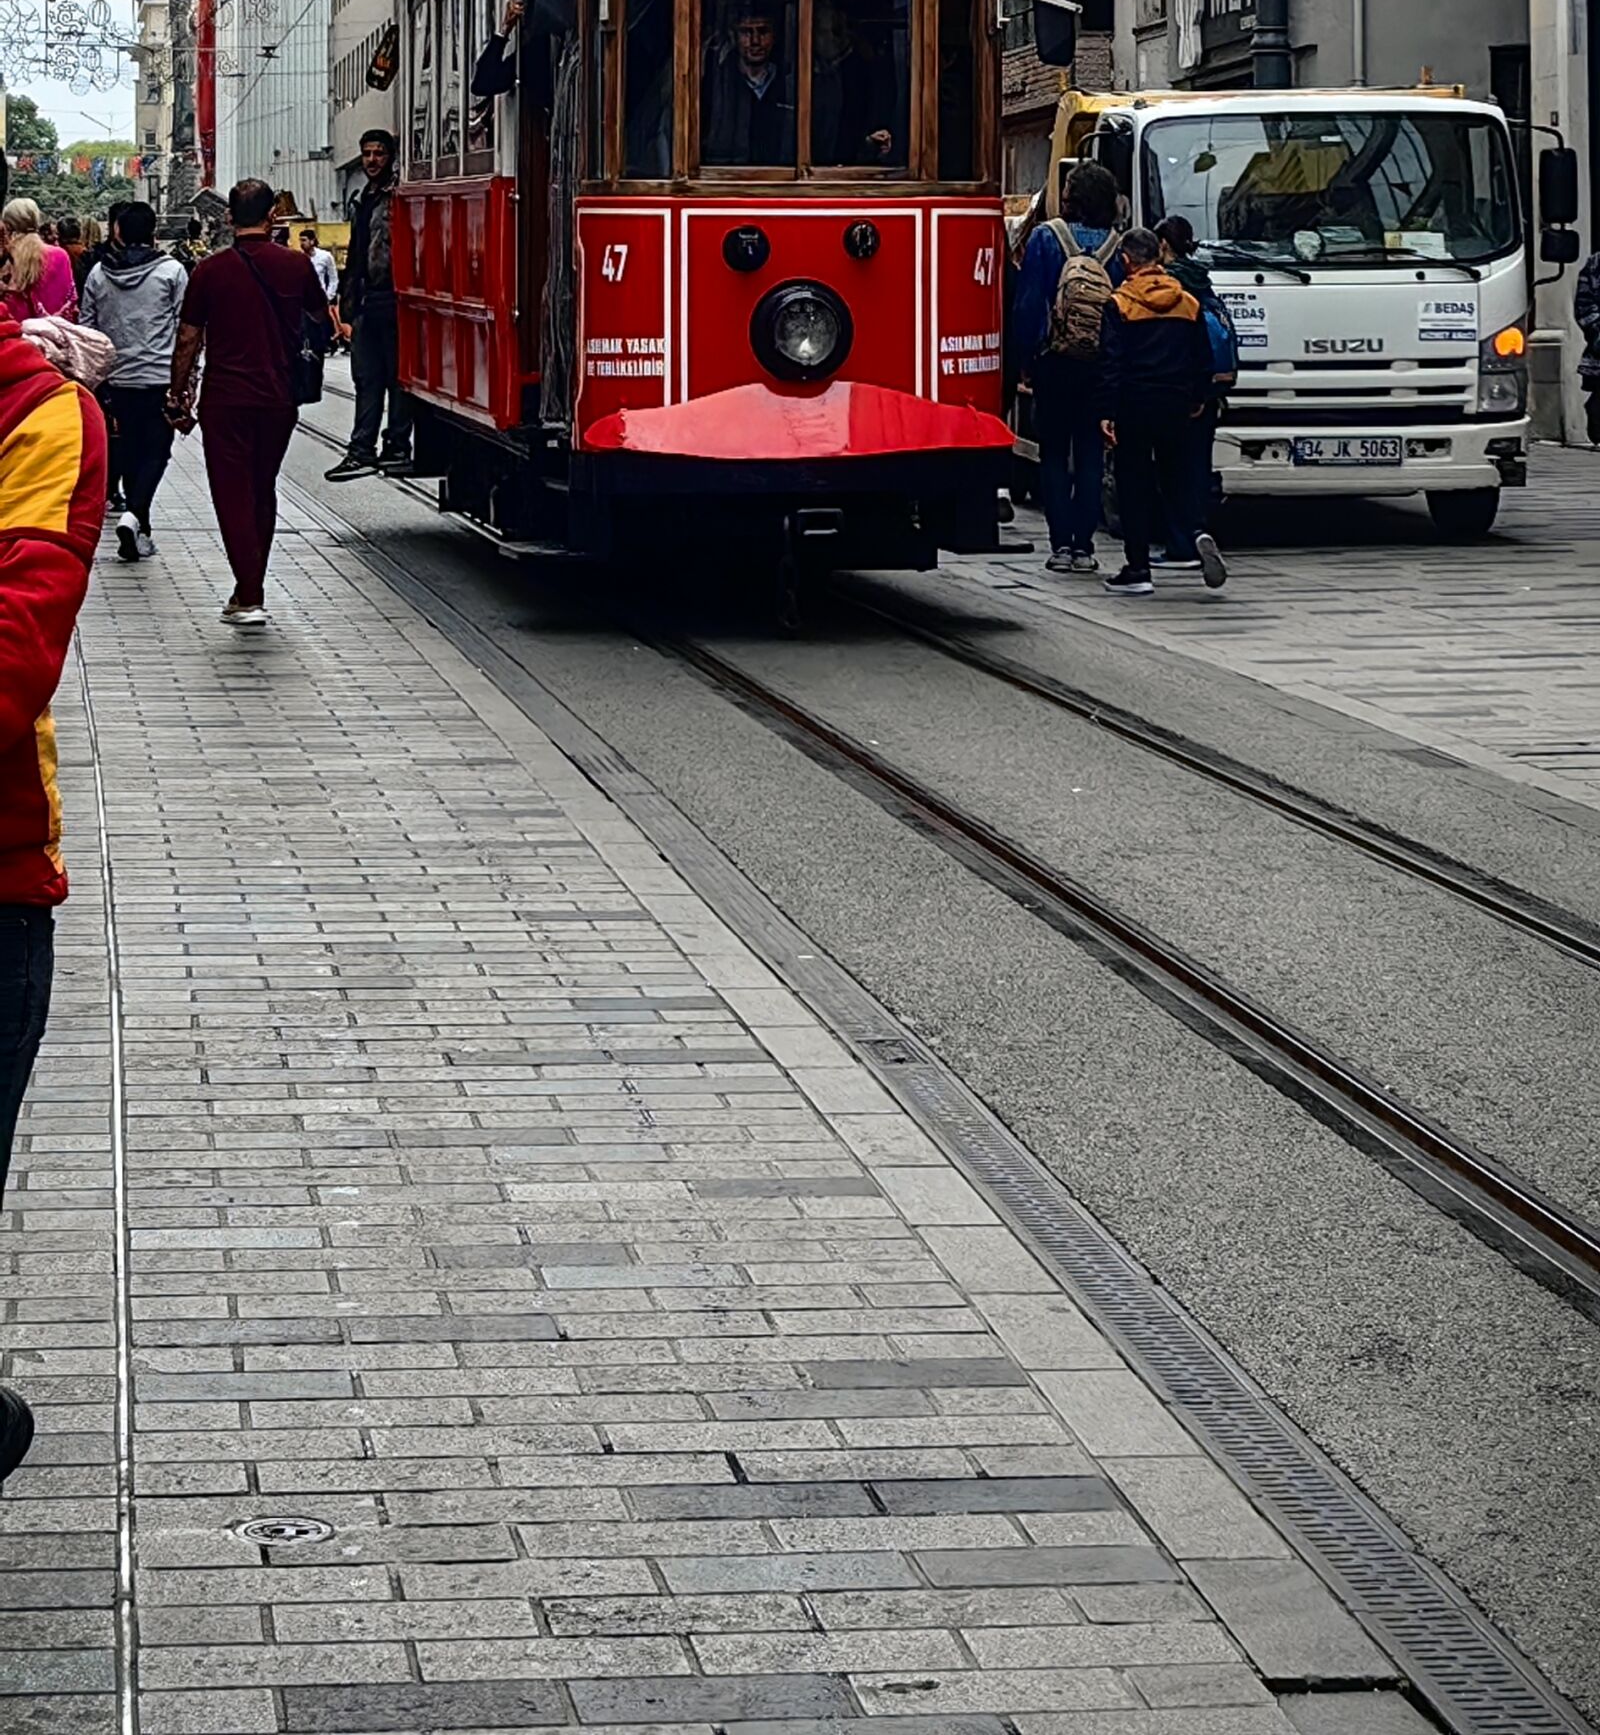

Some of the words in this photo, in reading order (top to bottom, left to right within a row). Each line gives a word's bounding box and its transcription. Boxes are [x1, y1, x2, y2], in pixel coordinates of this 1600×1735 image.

[602, 244, 628, 282] 47
[973, 247, 995, 285] 47
[1434, 302, 1475, 317] BEDAŞ
[1303, 338, 1384, 354] ISUZU
[941, 358, 955, 376] VE
[1303, 440, 1324, 458] 34
[1332, 440, 1352, 458] JK
[1360, 440, 1399, 458] 5063
